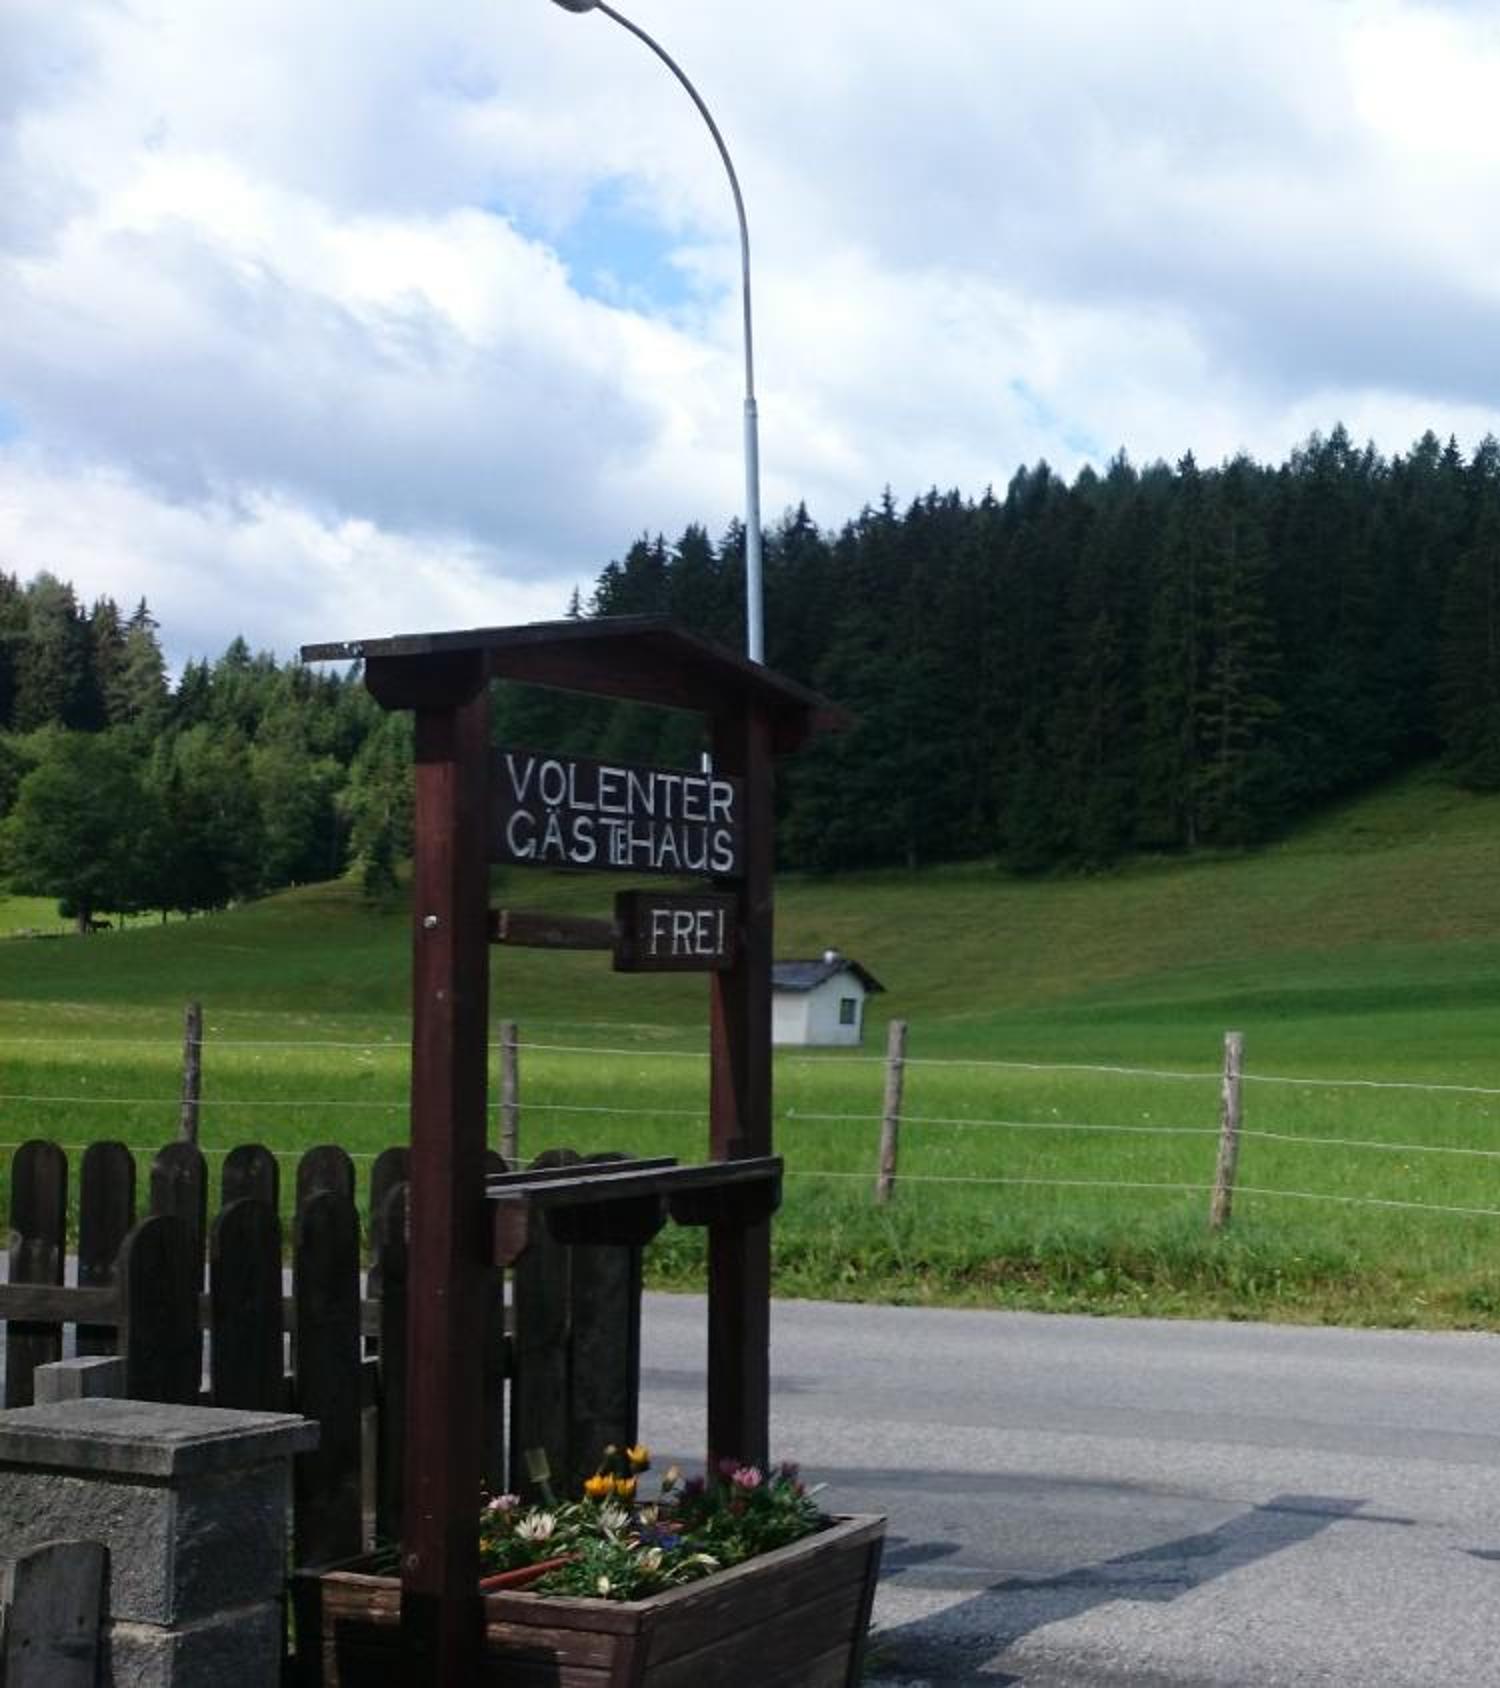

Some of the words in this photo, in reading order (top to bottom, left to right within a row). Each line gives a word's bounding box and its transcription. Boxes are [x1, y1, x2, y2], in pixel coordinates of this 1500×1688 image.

[505, 753, 735, 823] VOLENTER
[505, 804, 735, 872] GÄSTEHAUS
[650, 908, 725, 955] FREI
